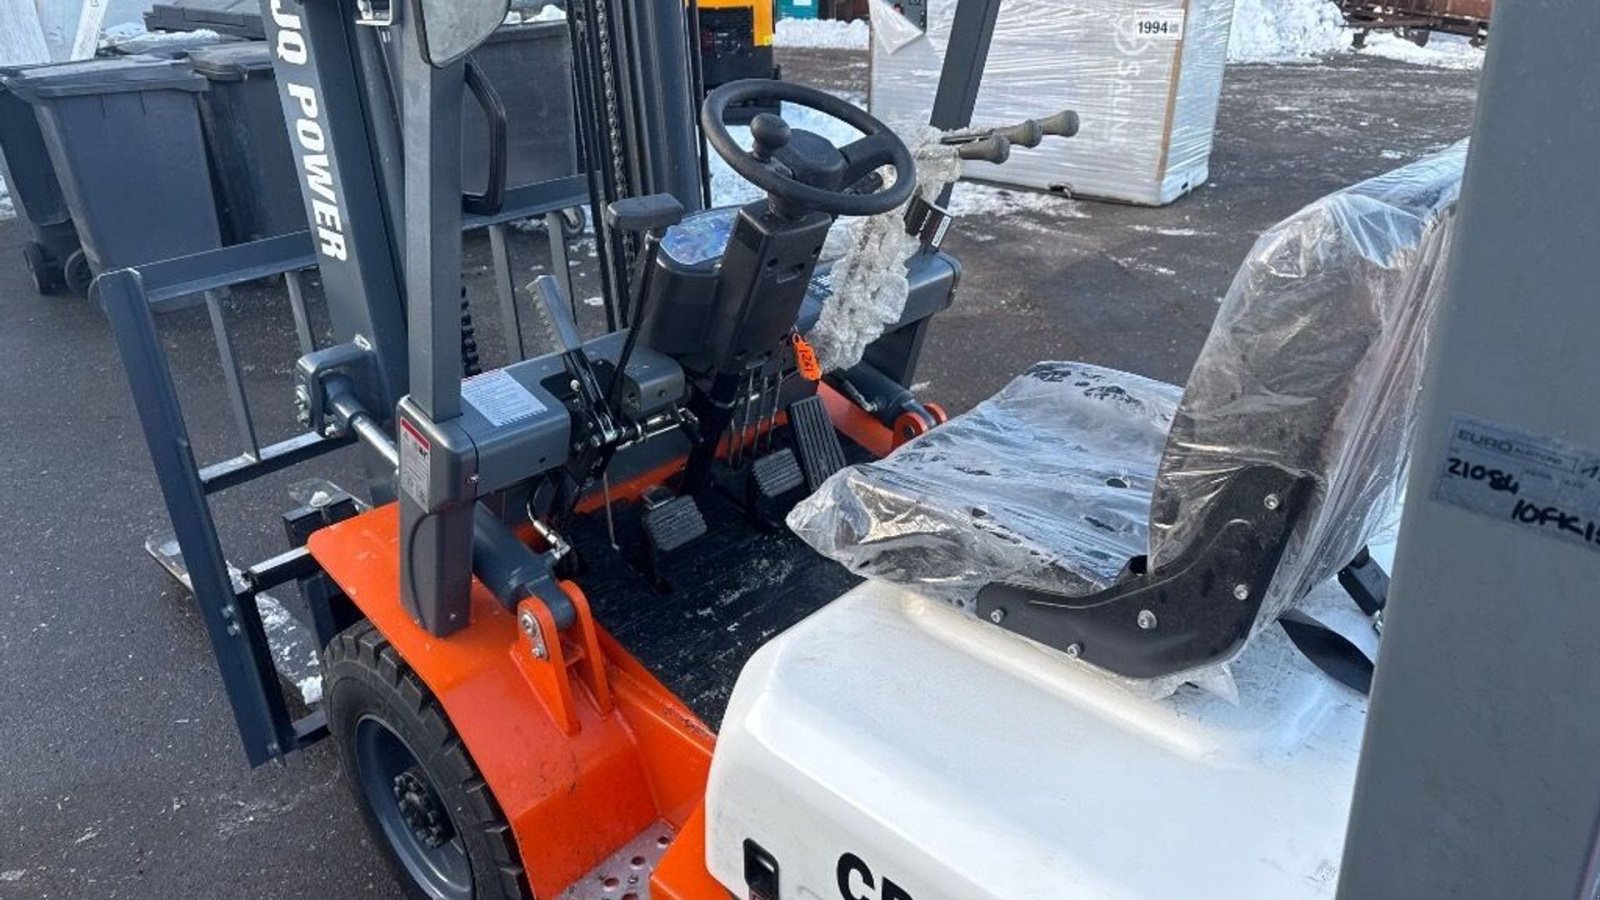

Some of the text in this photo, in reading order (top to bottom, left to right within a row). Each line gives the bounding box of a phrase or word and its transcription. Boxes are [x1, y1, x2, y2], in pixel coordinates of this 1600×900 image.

[1137, 20, 1168, 34] 1994
[270, 0, 348, 262] JQ POWER
[1457, 429, 1513, 453] EURO
